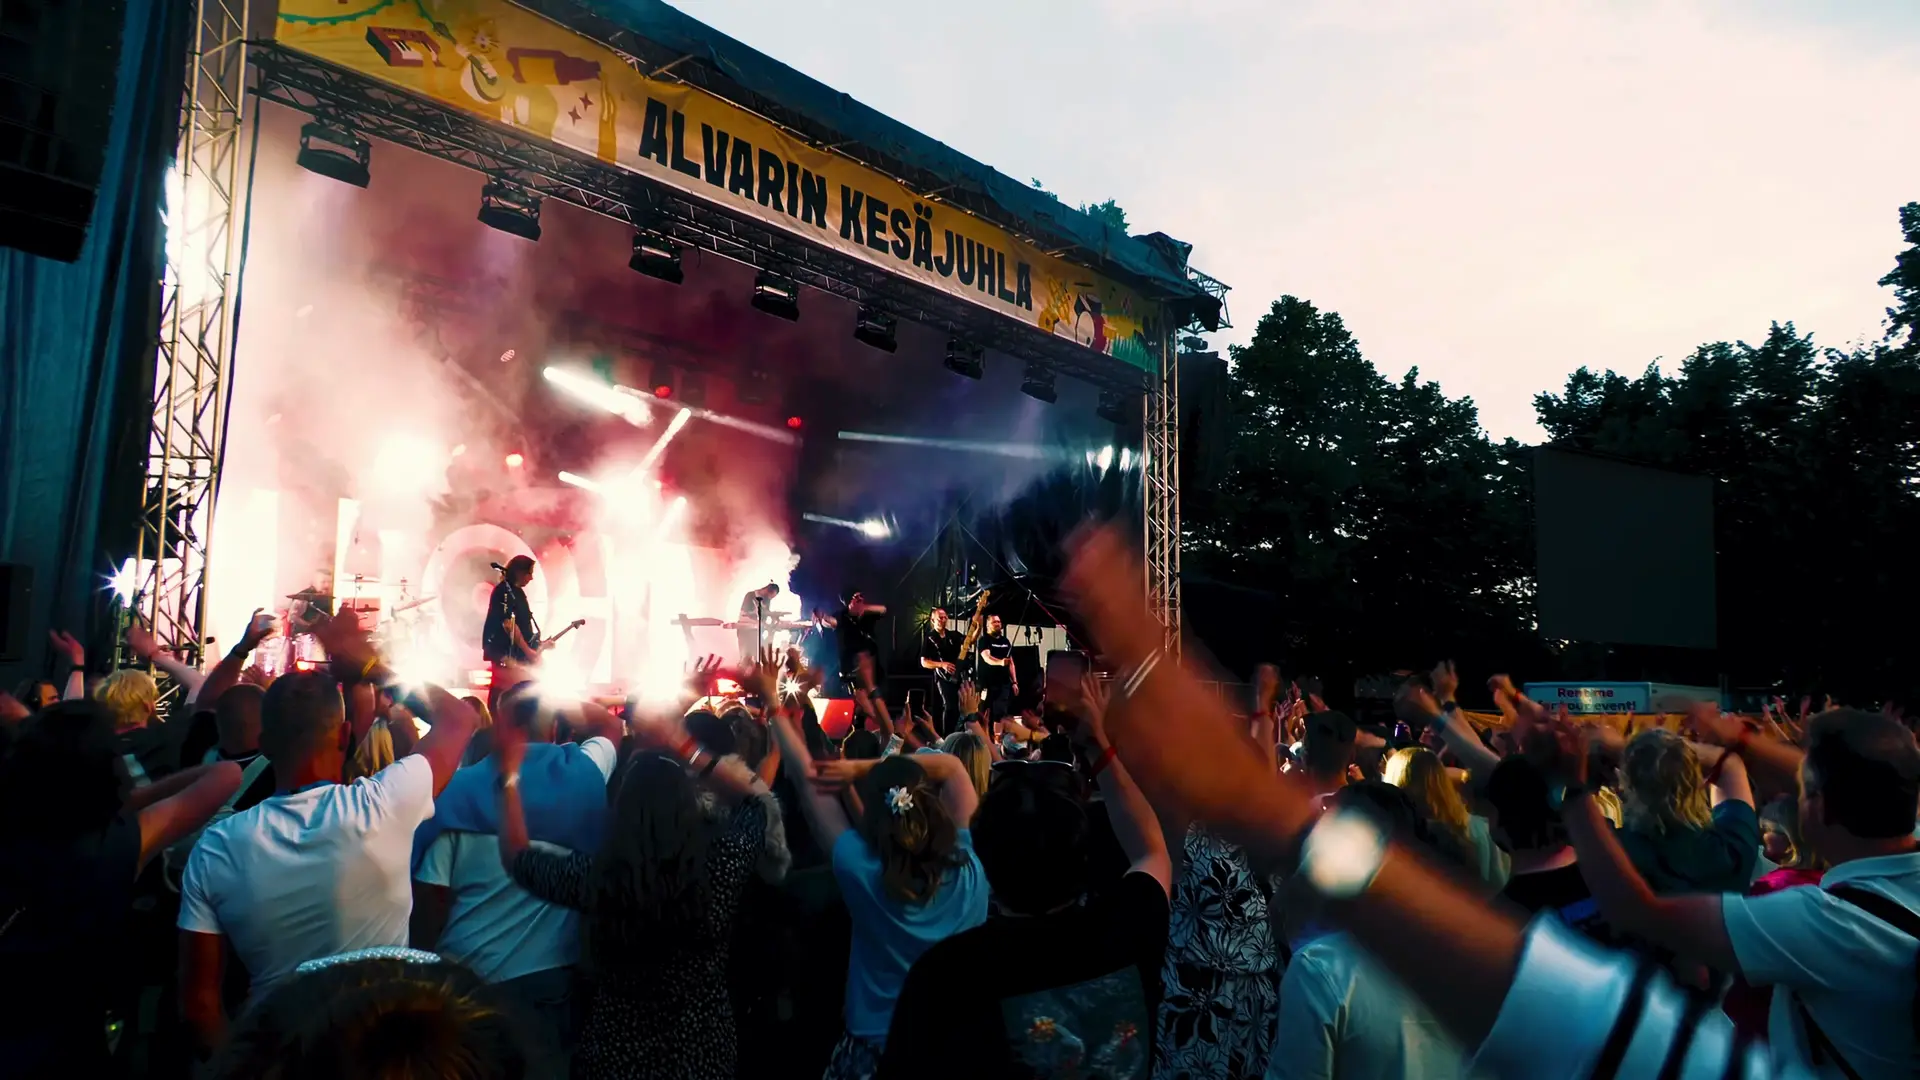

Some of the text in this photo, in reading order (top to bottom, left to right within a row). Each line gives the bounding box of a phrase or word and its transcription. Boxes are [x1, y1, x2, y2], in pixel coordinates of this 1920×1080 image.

[638, 96, 1033, 312] ALVARIN KESÄJUHLA
[1557, 687, 1614, 698] Rent me
[1559, 701, 1590, 712] our
